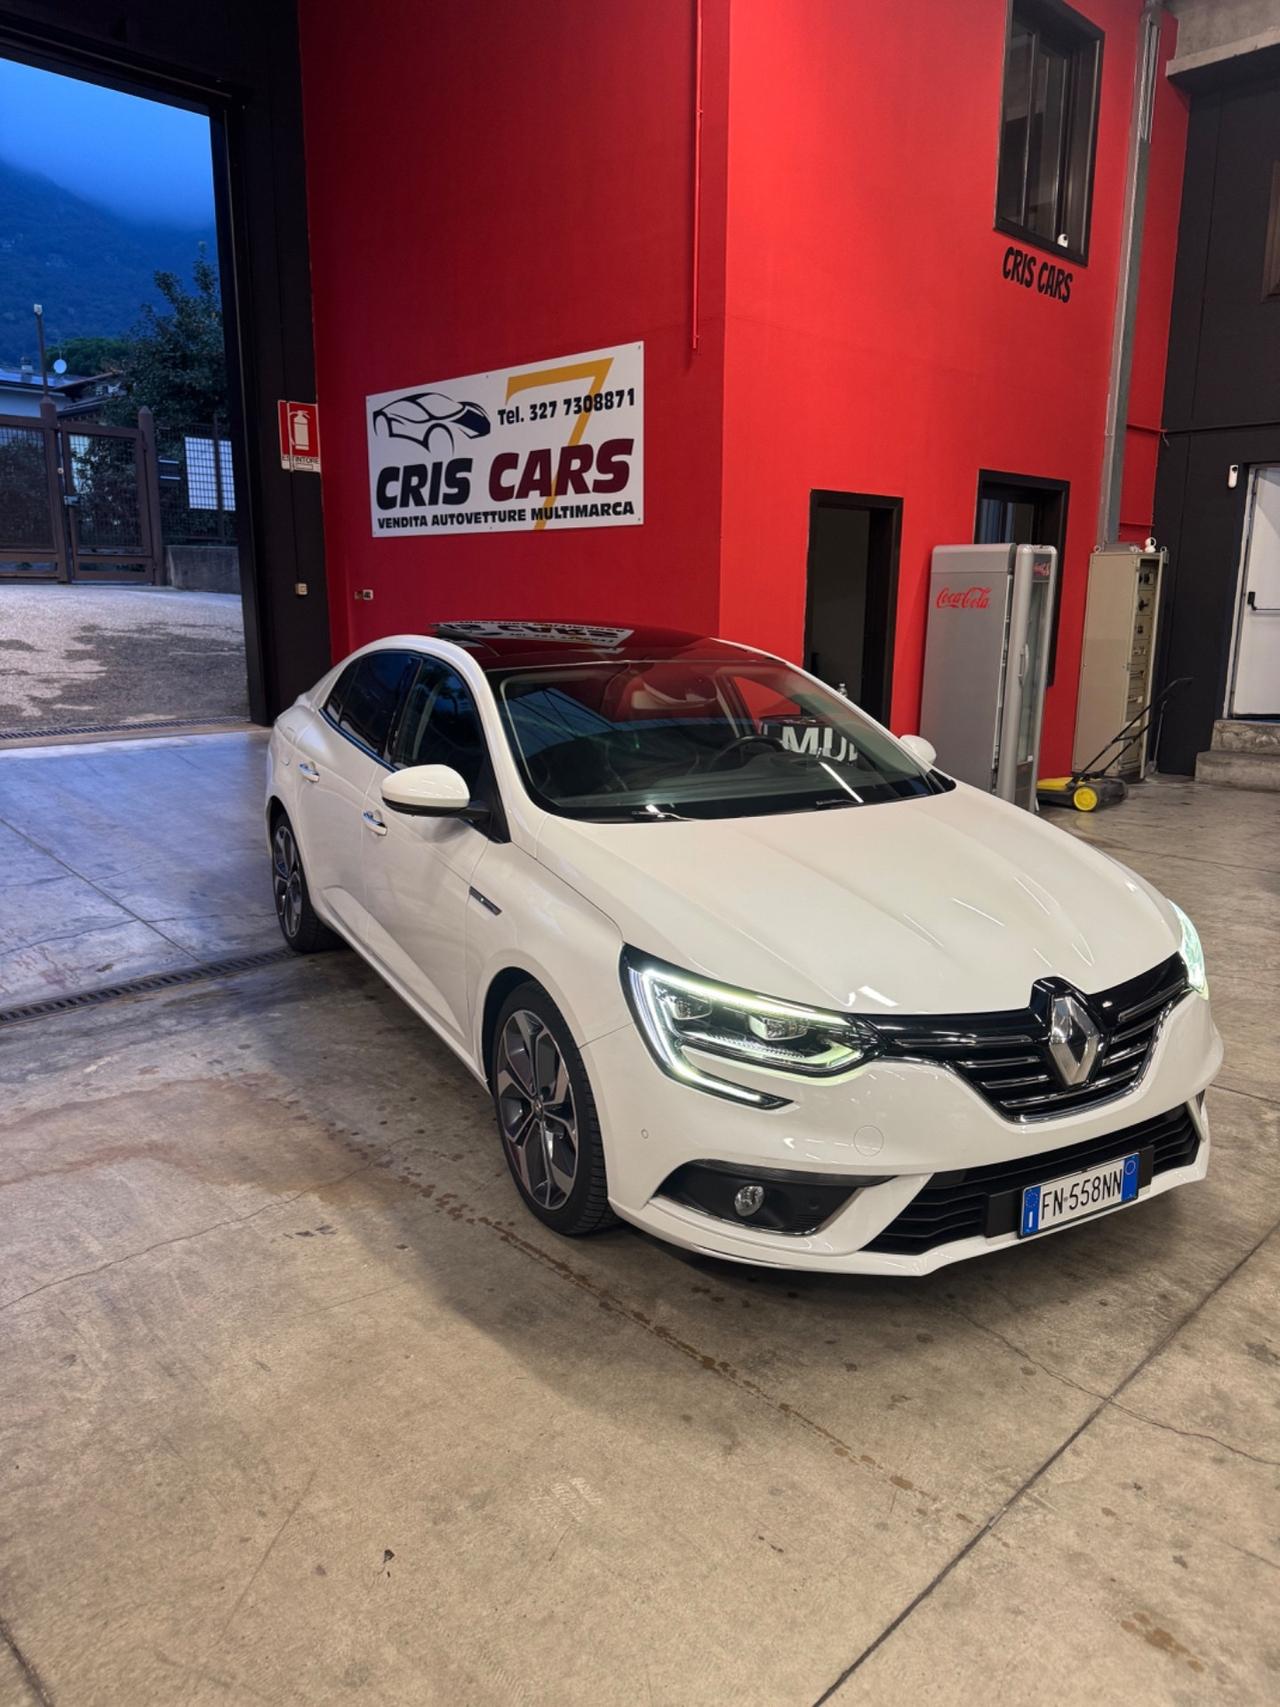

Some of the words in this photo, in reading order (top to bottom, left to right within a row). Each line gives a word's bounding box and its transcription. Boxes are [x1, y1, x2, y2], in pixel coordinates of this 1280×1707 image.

[1003, 246, 1036, 288] CRIS
[1037, 262, 1073, 303] CARS
[498, 406, 525, 426] Tel.
[529, 401, 557, 421] 327
[563, 388, 635, 416] 7308871
[281, 455, 319, 465] ESINTORE
[375, 457, 473, 510] CRIS
[488, 438, 634, 502] CARS
[378, 514, 429, 529] VENDITA
[431, 508, 526, 526] AUTOVETTURE
[531, 501, 635, 521] MULTIMARCA
